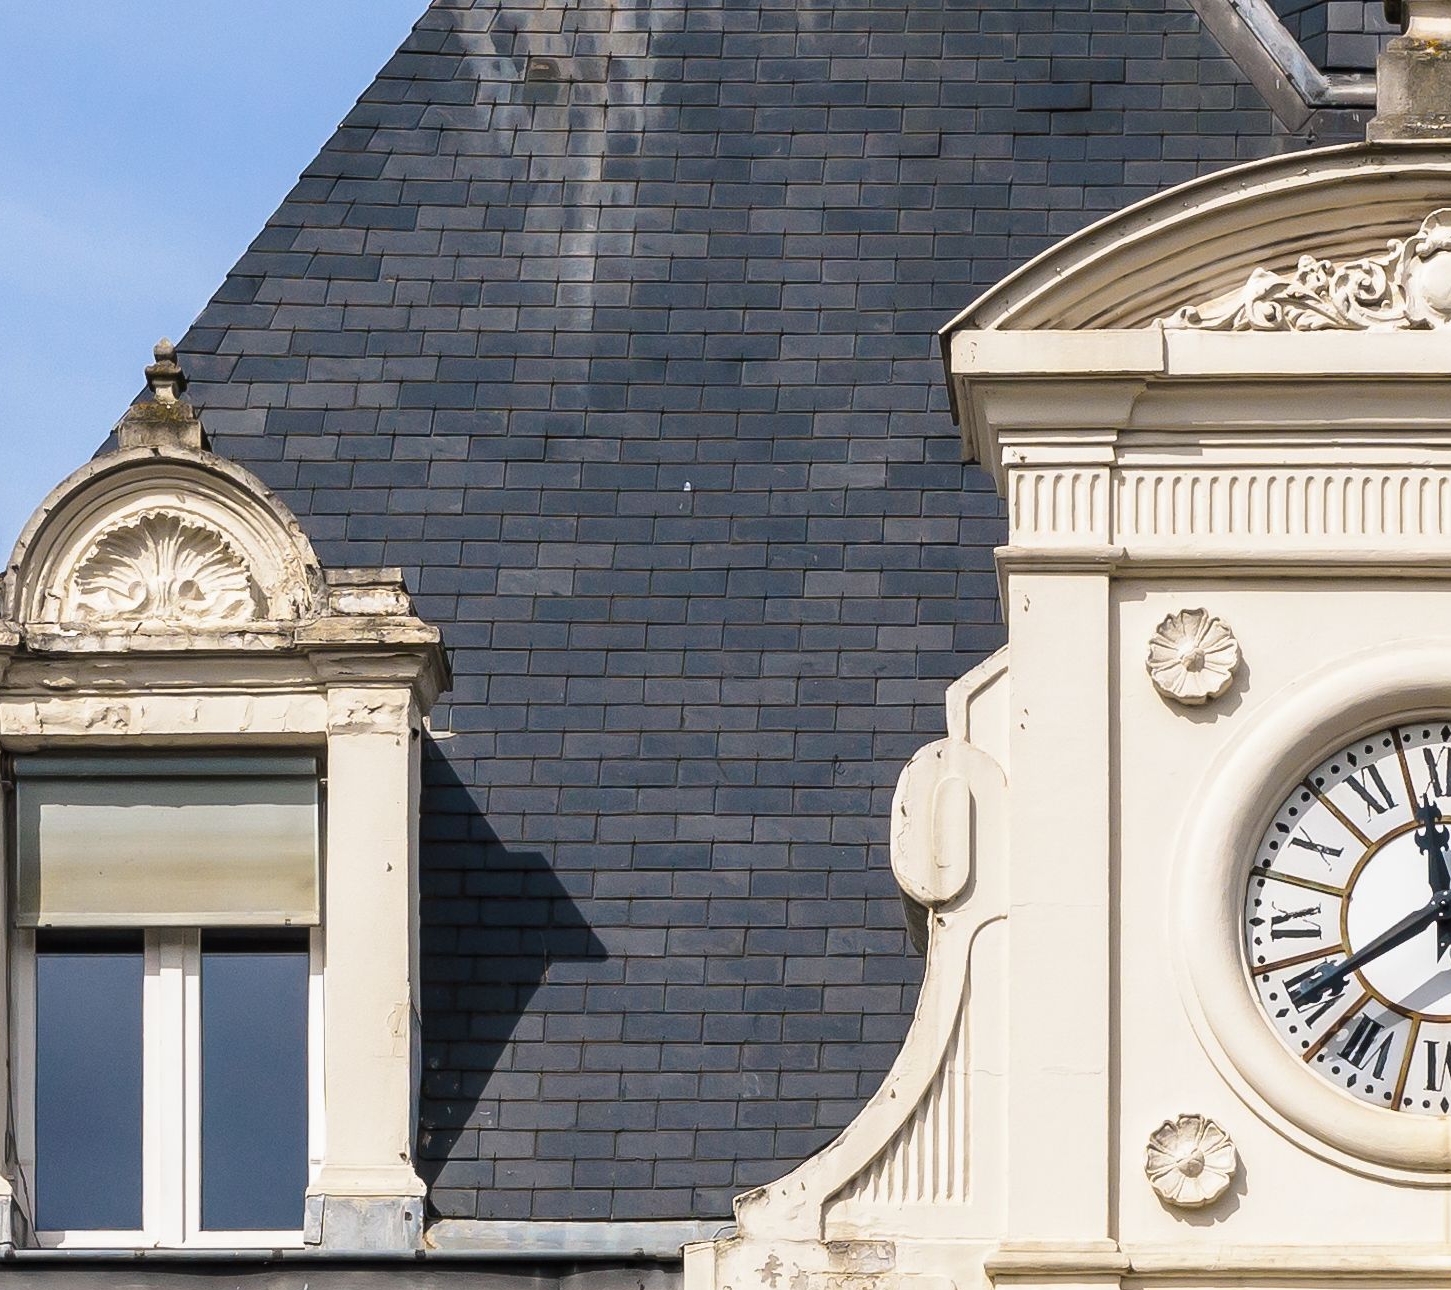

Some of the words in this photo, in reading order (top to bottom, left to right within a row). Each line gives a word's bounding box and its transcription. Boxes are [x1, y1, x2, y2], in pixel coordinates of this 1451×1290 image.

[1343, 763, 1399, 823] XI
[1288, 825, 1345, 872] X
[1270, 901, 1323, 942] IX
[1337, 1012, 1395, 1082] VII
